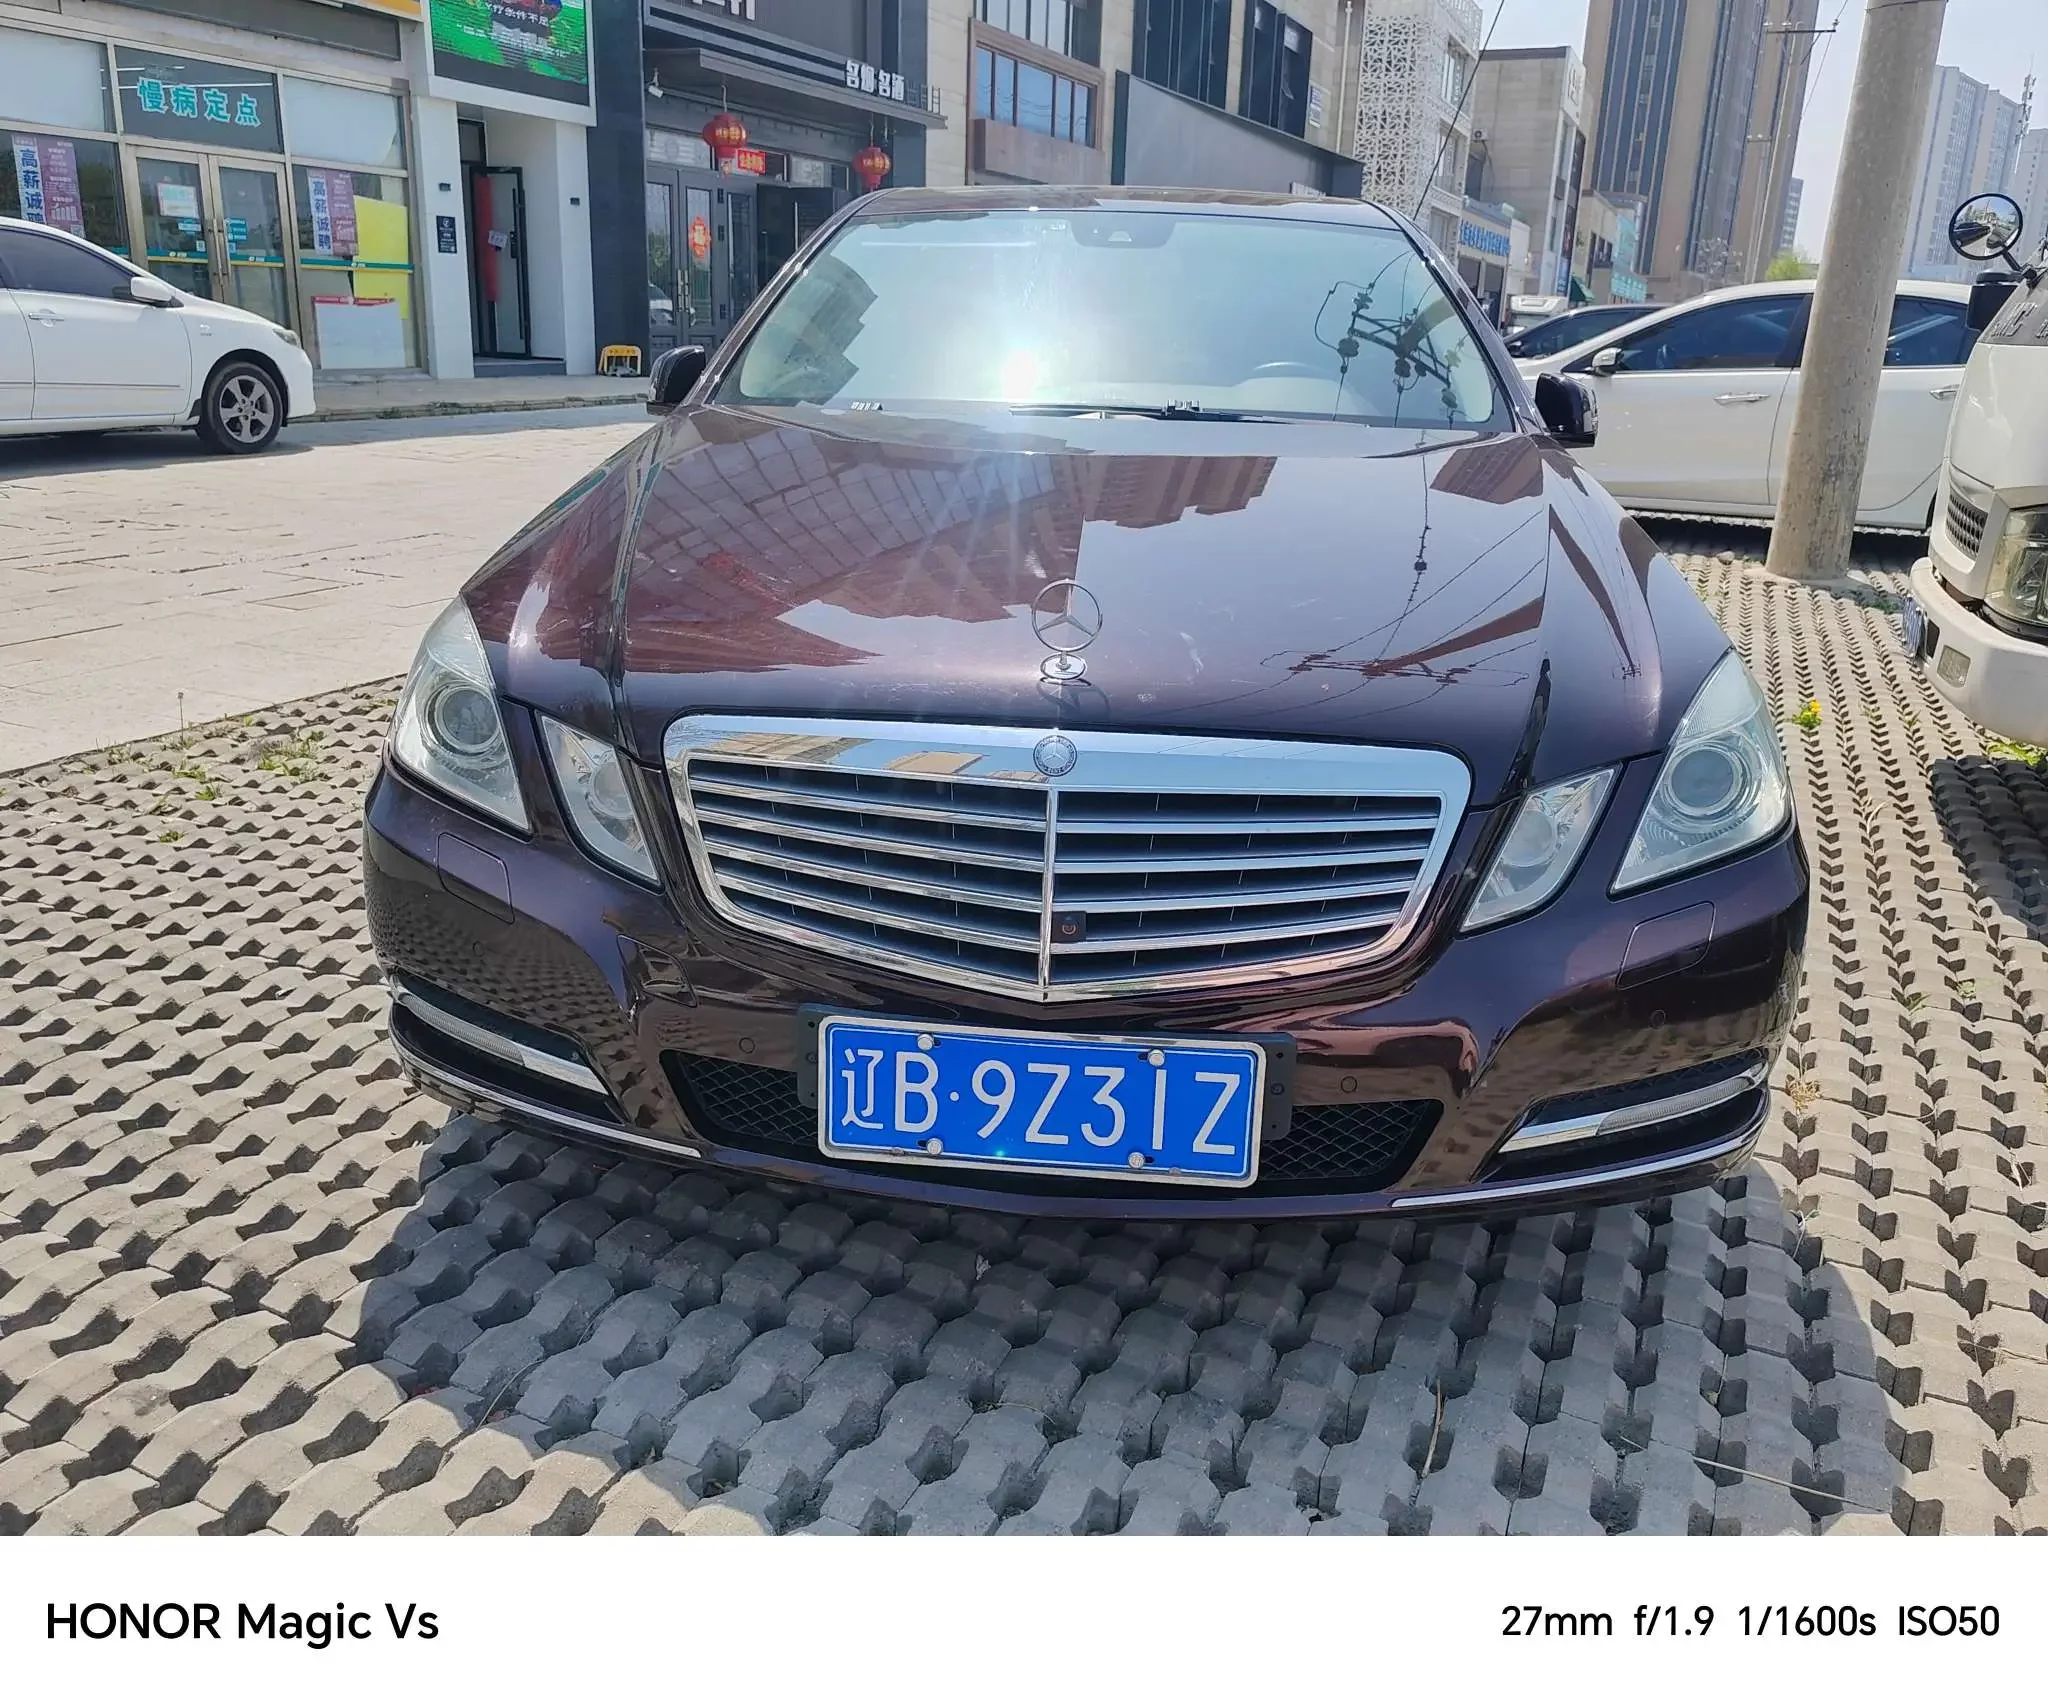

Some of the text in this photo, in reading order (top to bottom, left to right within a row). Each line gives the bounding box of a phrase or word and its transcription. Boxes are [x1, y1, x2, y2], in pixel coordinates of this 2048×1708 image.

[137, 76, 262, 127] 慢病定点
[312, 181, 331, 249] 高薪诚聘
